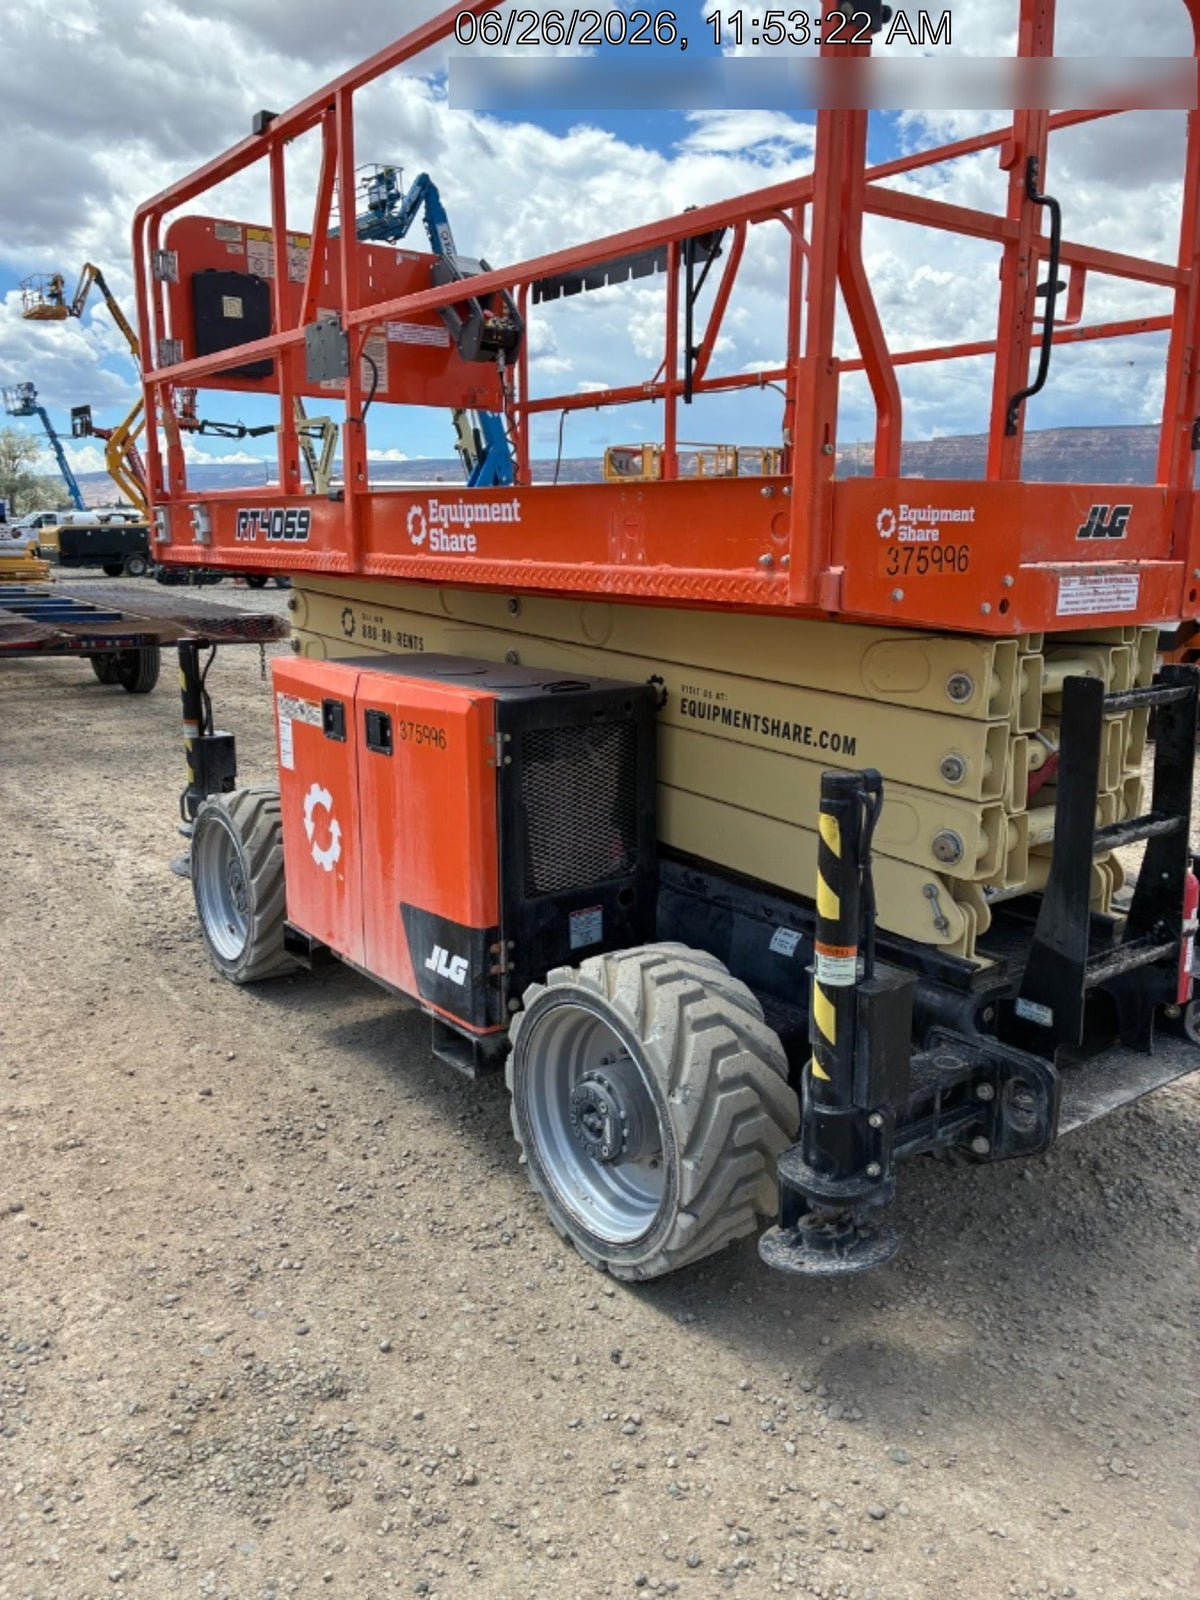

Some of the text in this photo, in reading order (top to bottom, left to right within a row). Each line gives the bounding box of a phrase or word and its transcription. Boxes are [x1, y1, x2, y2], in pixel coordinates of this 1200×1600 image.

[236, 507, 310, 541] RT4069
[428, 498, 521, 525] Equipment
[898, 505, 975, 525] Equipment
[1075, 504, 1133, 541] JLG
[429, 528, 477, 553] Share
[898, 526, 939, 542] Share
[886, 545, 970, 576] 375996
[681, 684, 728, 701] VISIT US AT:
[400, 721, 447, 749] 375996
[680, 698, 857, 756] EQUIPMENTSHARE.COM
[425, 945, 467, 985] JLG
